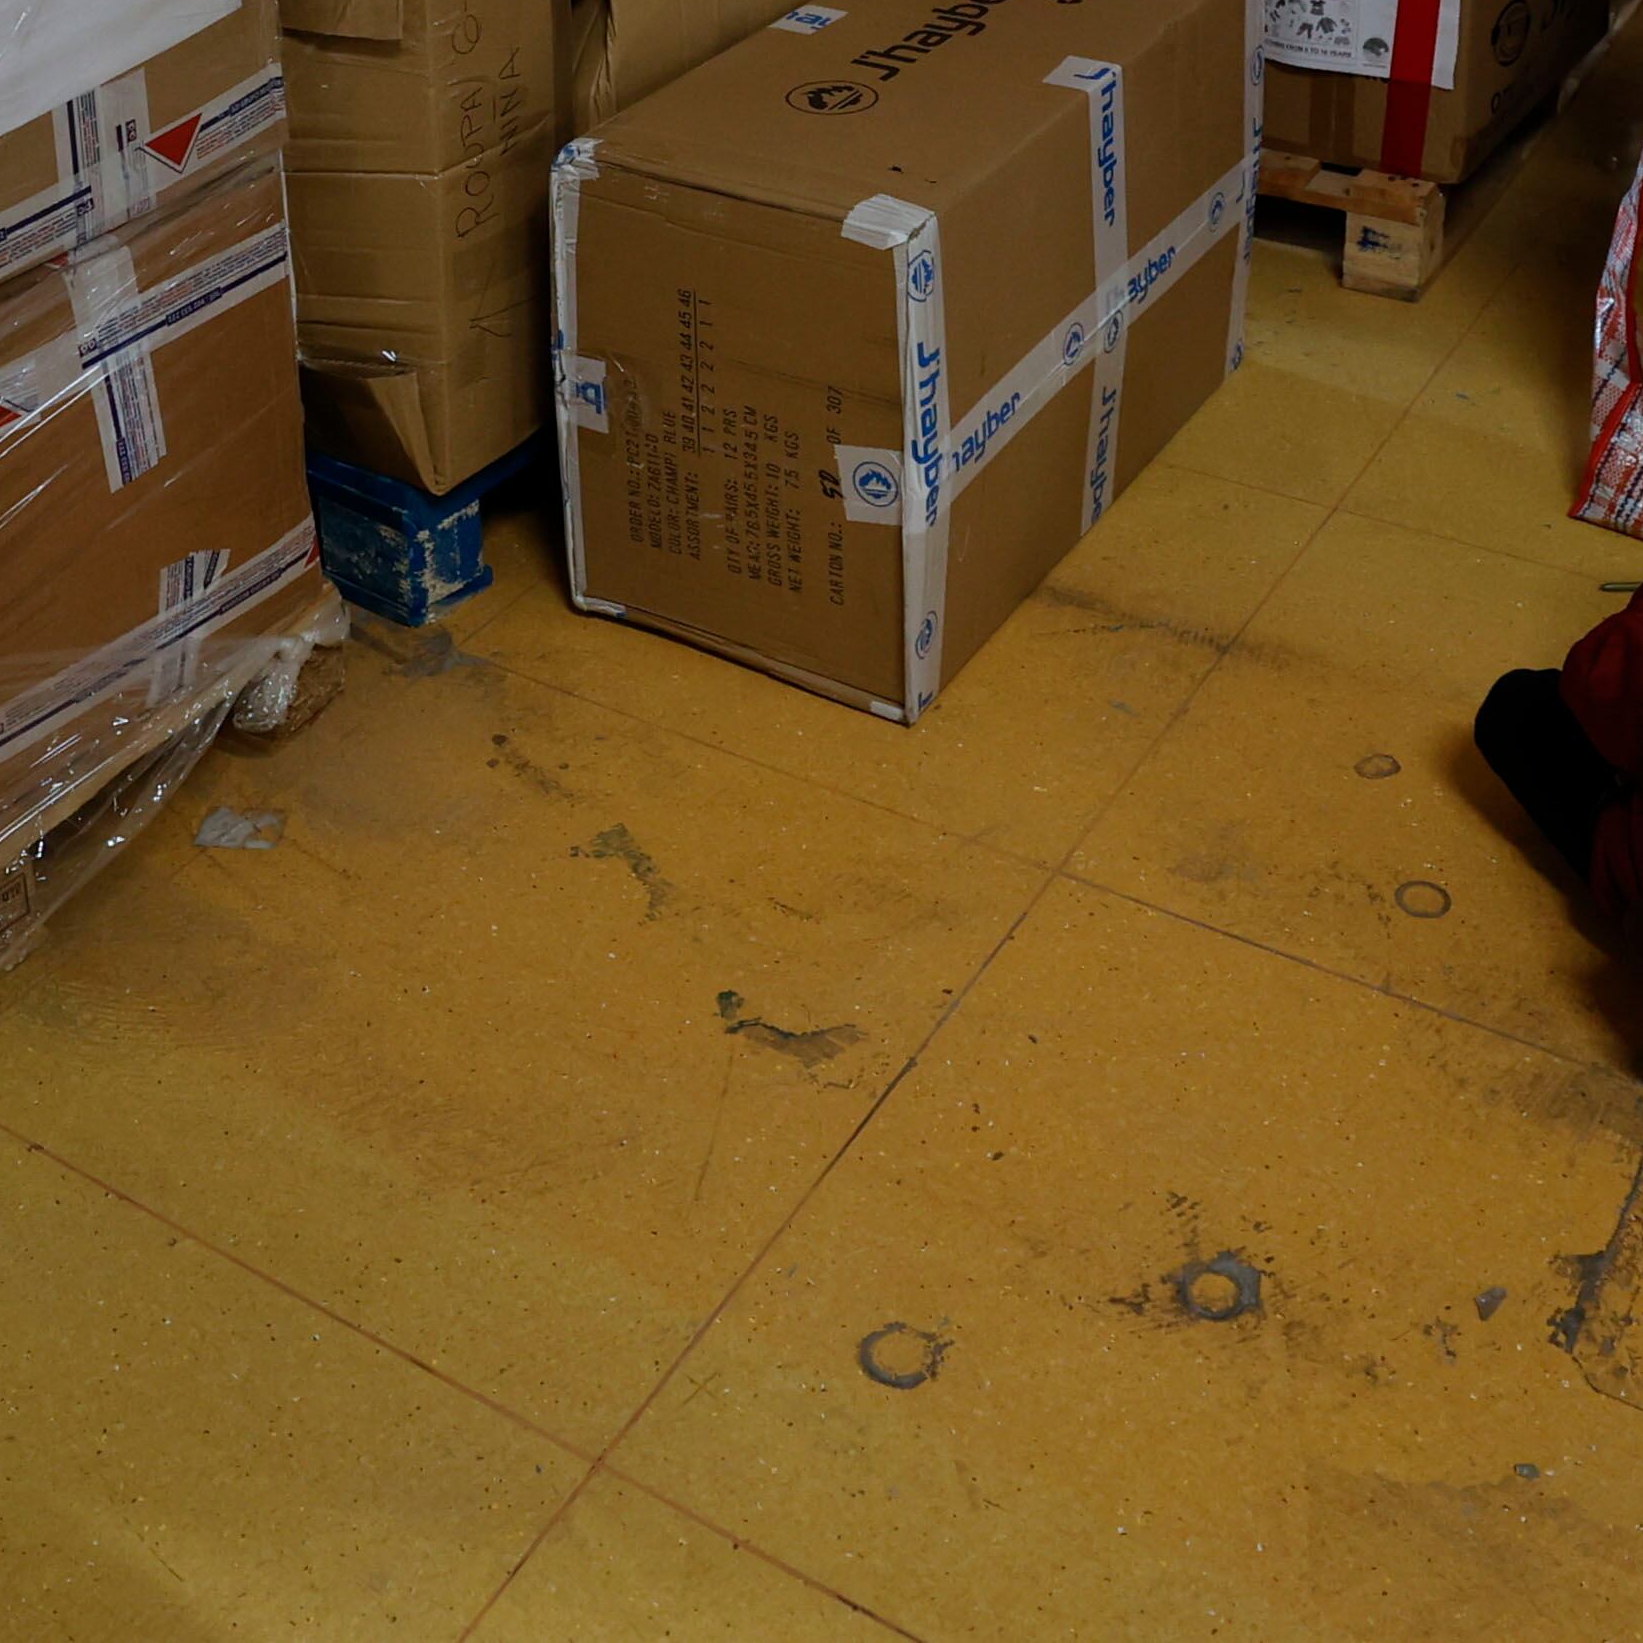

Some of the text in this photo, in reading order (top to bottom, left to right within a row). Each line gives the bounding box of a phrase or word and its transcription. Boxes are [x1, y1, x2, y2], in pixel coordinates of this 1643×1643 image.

[698, 340, 714, 351] 2
[699, 360, 715, 372] 2
[700, 382, 715, 394] 2
[825, 385, 843, 415] 307
[677, 289, 702, 561] ASSORTMENT: 39 40 41 42 43 44 45 46
[700, 404, 715, 416] 2
[722, 408, 738, 436] PRS
[743, 404, 758, 426] CM
[662, 410, 677, 446] BLUE
[826, 427, 842, 446] OF
[910, 339, 941, 527] J'hayber
[723, 441, 739, 461] 12
[762, 414, 782, 586] GROSS WEIGHT: 10 KGS
[783, 430, 803, 594] NET WEIGHT: KGS
[628, 499, 644, 543] ORDER
[646, 494, 663, 549] MODELO:
[666, 507, 682, 555] COLOR:
[724, 526, 741, 545] OF
[828, 554, 845, 606] CARTON
